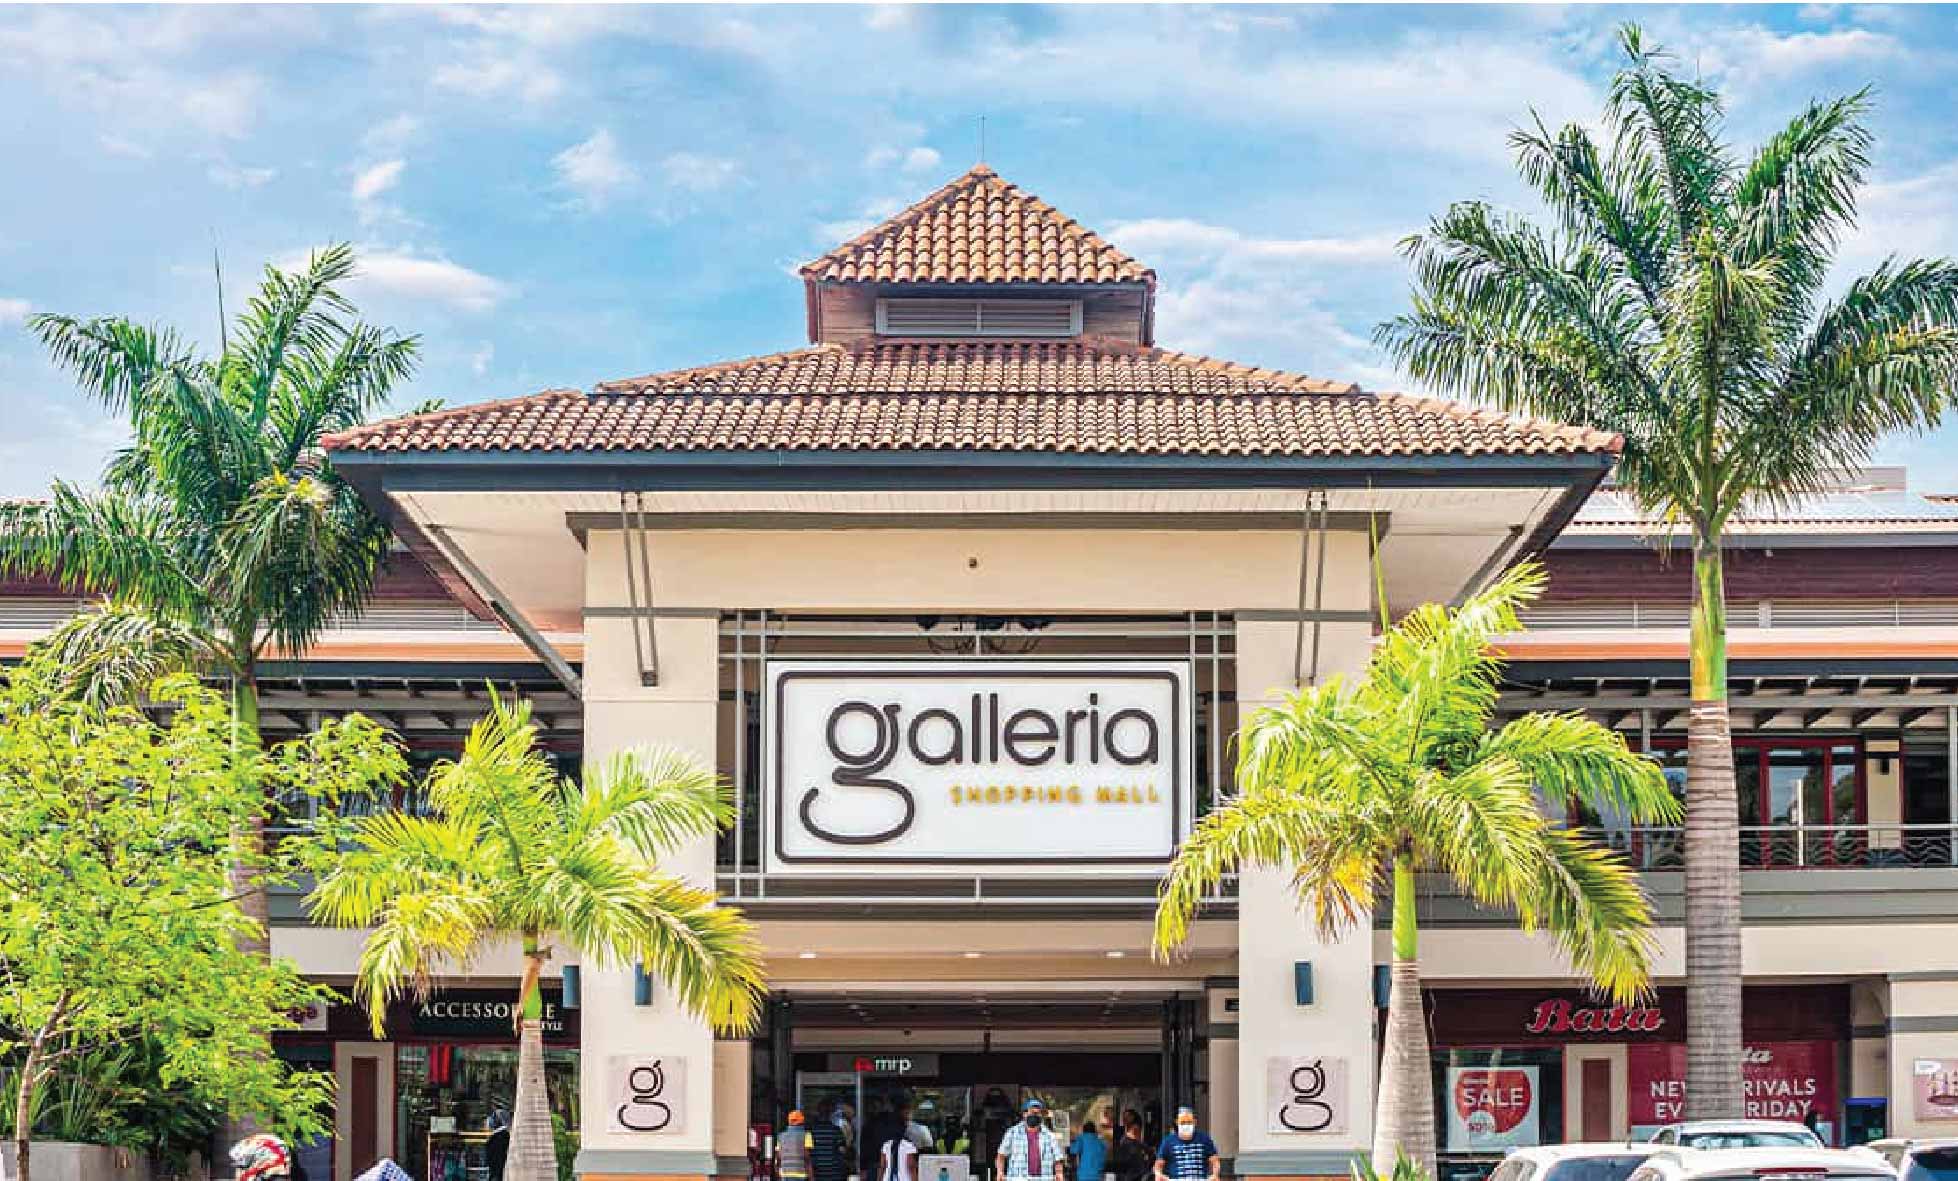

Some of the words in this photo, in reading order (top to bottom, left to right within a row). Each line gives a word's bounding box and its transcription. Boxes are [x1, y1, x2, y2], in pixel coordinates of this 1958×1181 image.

[799, 692, 1159, 845] galleria
[949, 785, 1083, 807] SHOPPING
[1096, 785, 1160, 805] MALL
[419, 1001, 556, 1019] ACCESSOE
[1526, 998, 1666, 1032] Bata
[875, 1058, 912, 1076] mrp
[618, 1059, 671, 1132] g
[1279, 1059, 1332, 1132] g
[1463, 1087, 1524, 1107] SALE
[1747, 1100, 1813, 1119] RIDAY
